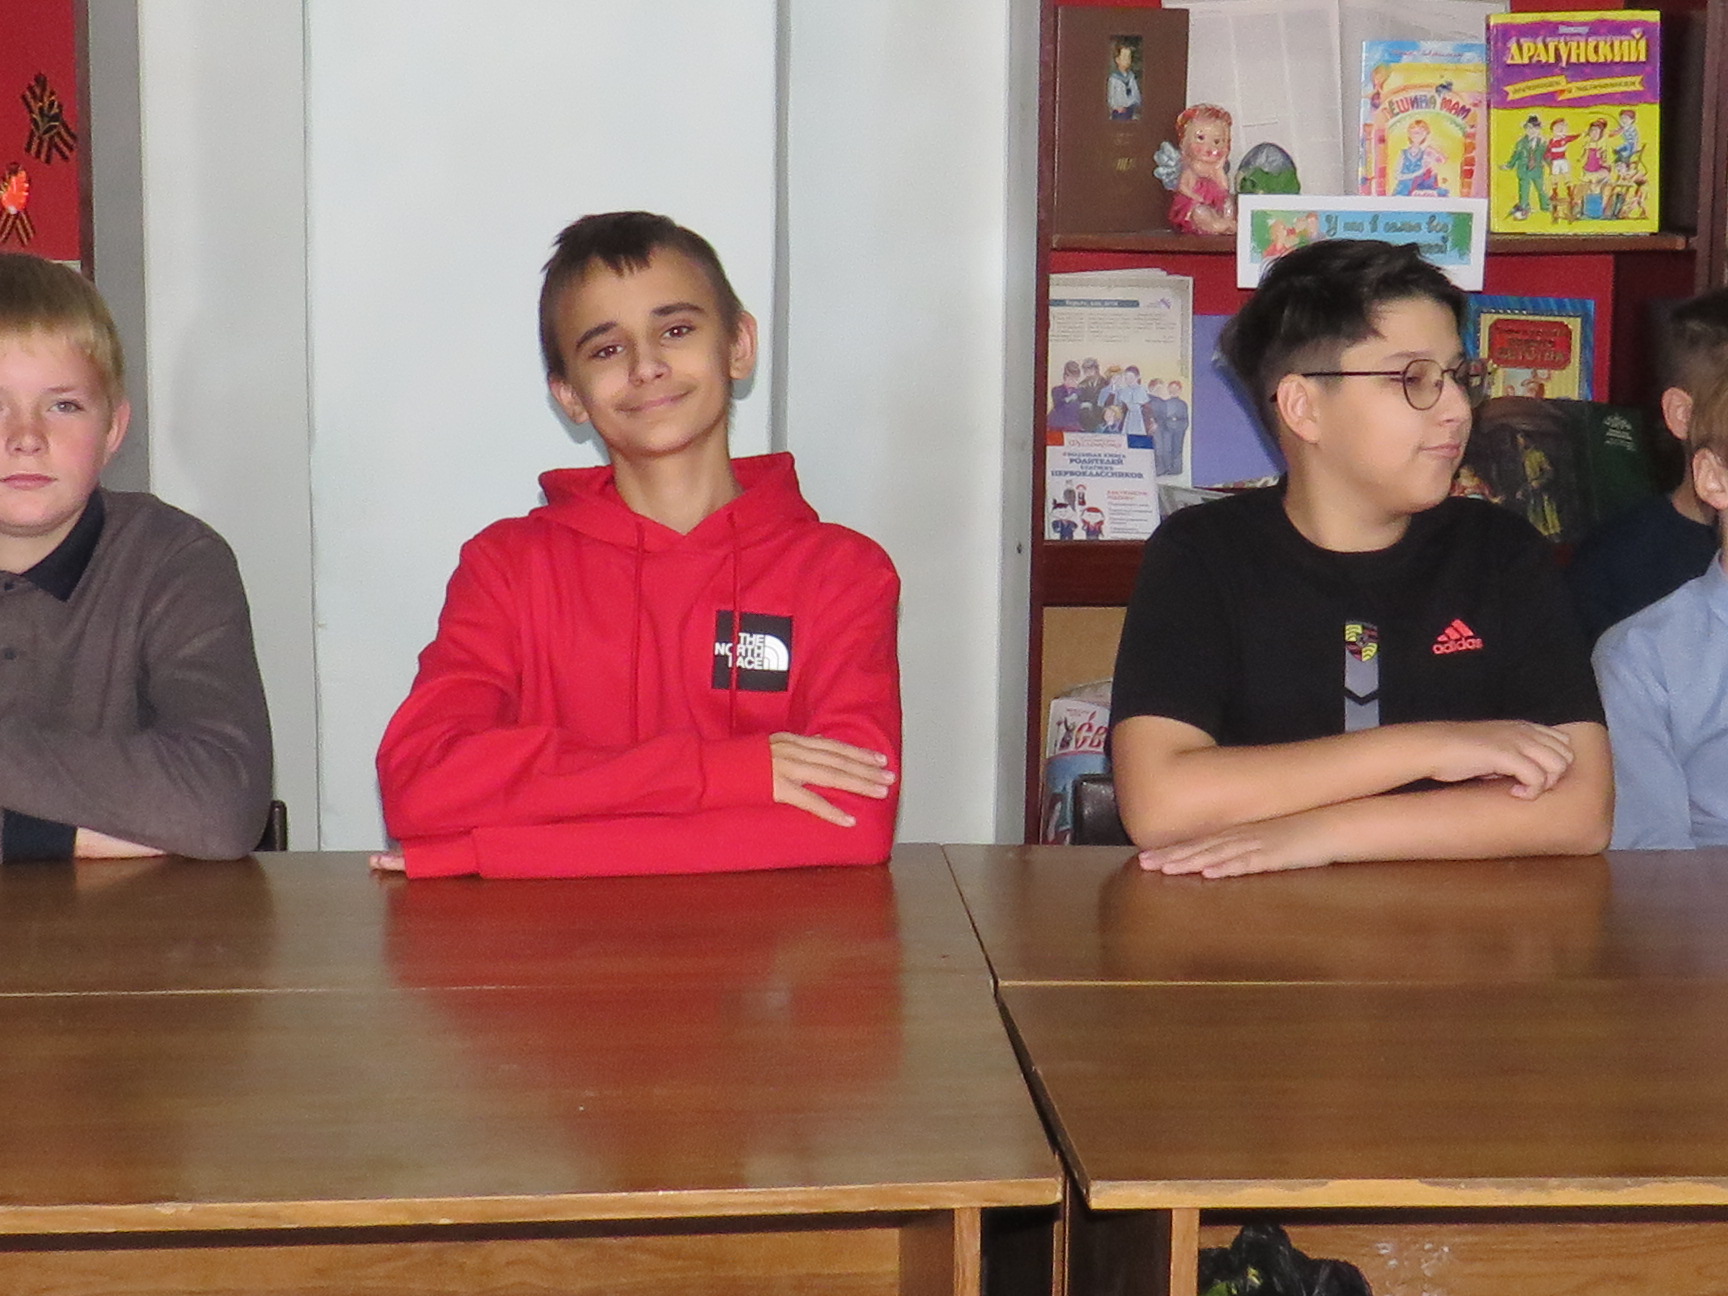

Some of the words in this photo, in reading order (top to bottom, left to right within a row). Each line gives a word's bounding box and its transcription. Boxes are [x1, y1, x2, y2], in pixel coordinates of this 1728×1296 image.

[1505, 29, 1649, 68] ДРАГУНСКИЙ
[738, 632, 765, 646] THE
[1432, 637, 1485, 654] adidas
